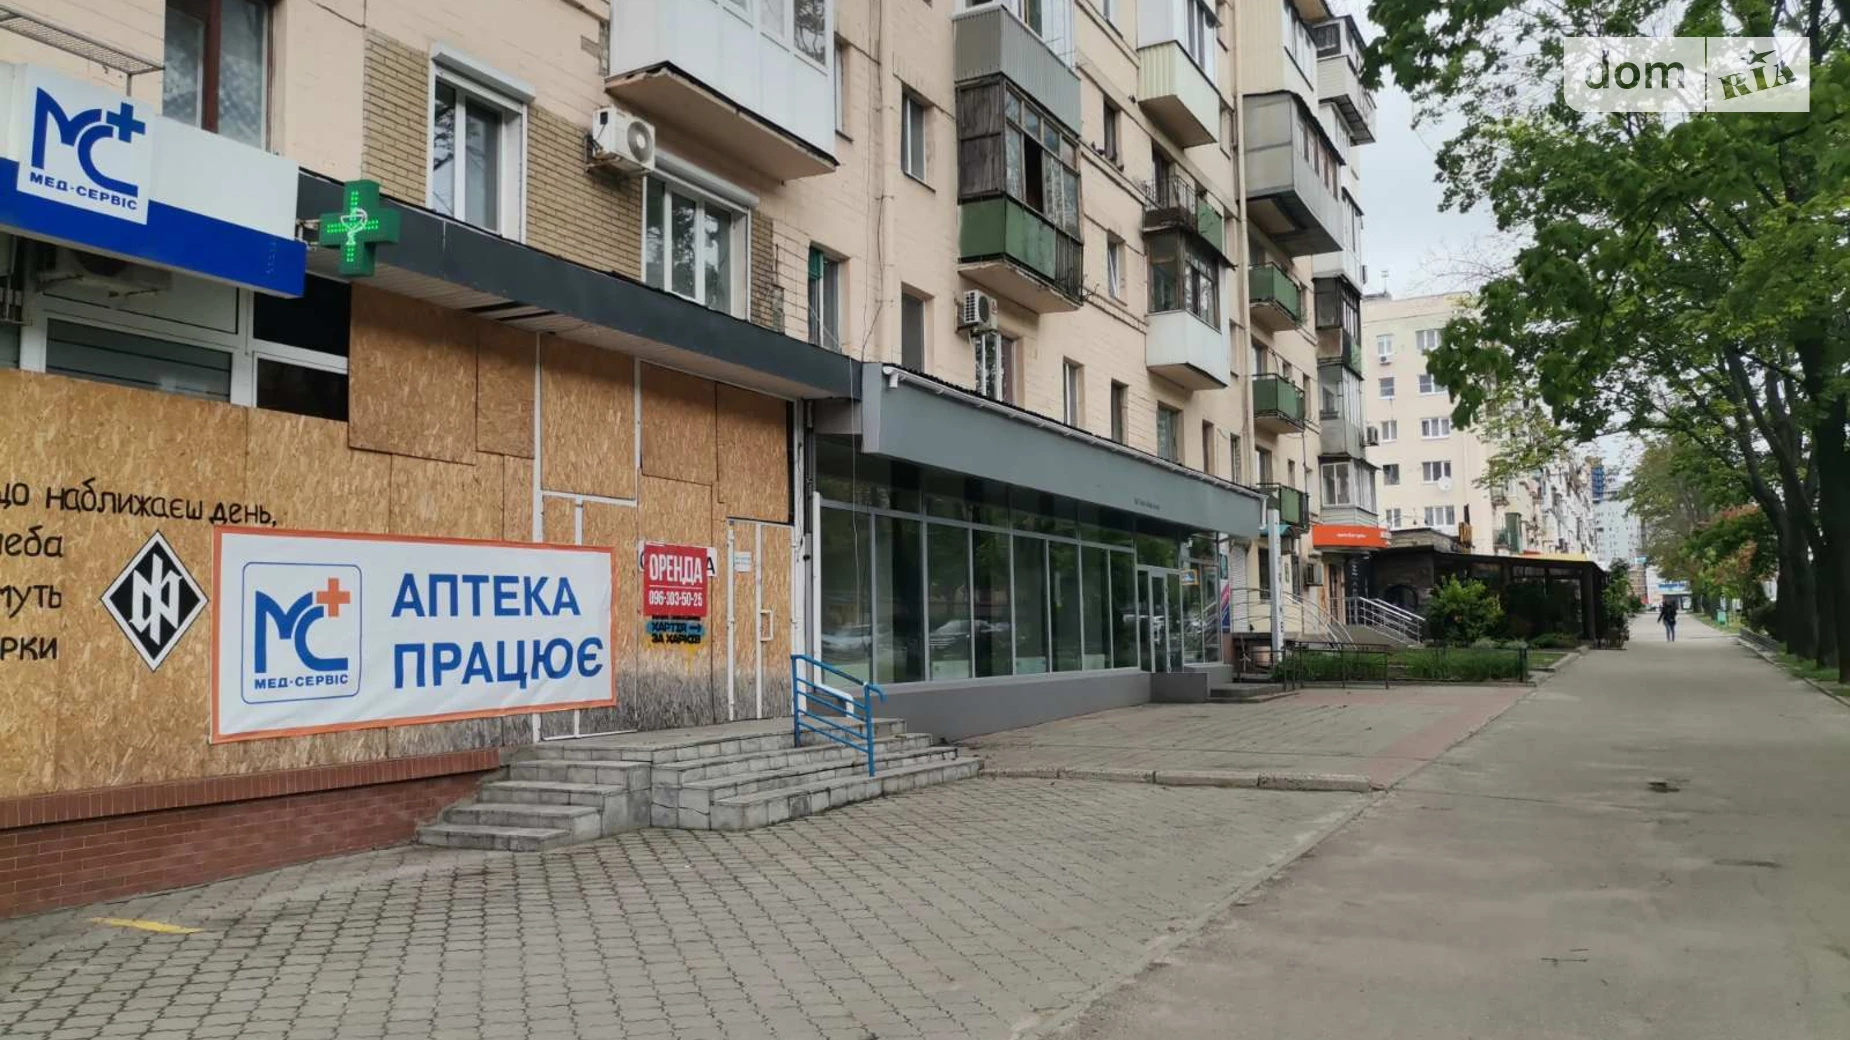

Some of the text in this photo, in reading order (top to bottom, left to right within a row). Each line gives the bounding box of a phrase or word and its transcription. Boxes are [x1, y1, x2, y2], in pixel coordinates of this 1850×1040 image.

[46, 477, 203, 520] наближаєш
[208, 502, 278, 527] день,
[0, 525, 63, 558] еба
[649, 553, 703, 585] ОРЕНДА
[391, 572, 581, 618] АПТЕКА
[393, 637, 604, 689] ПРАЦЮЄ
